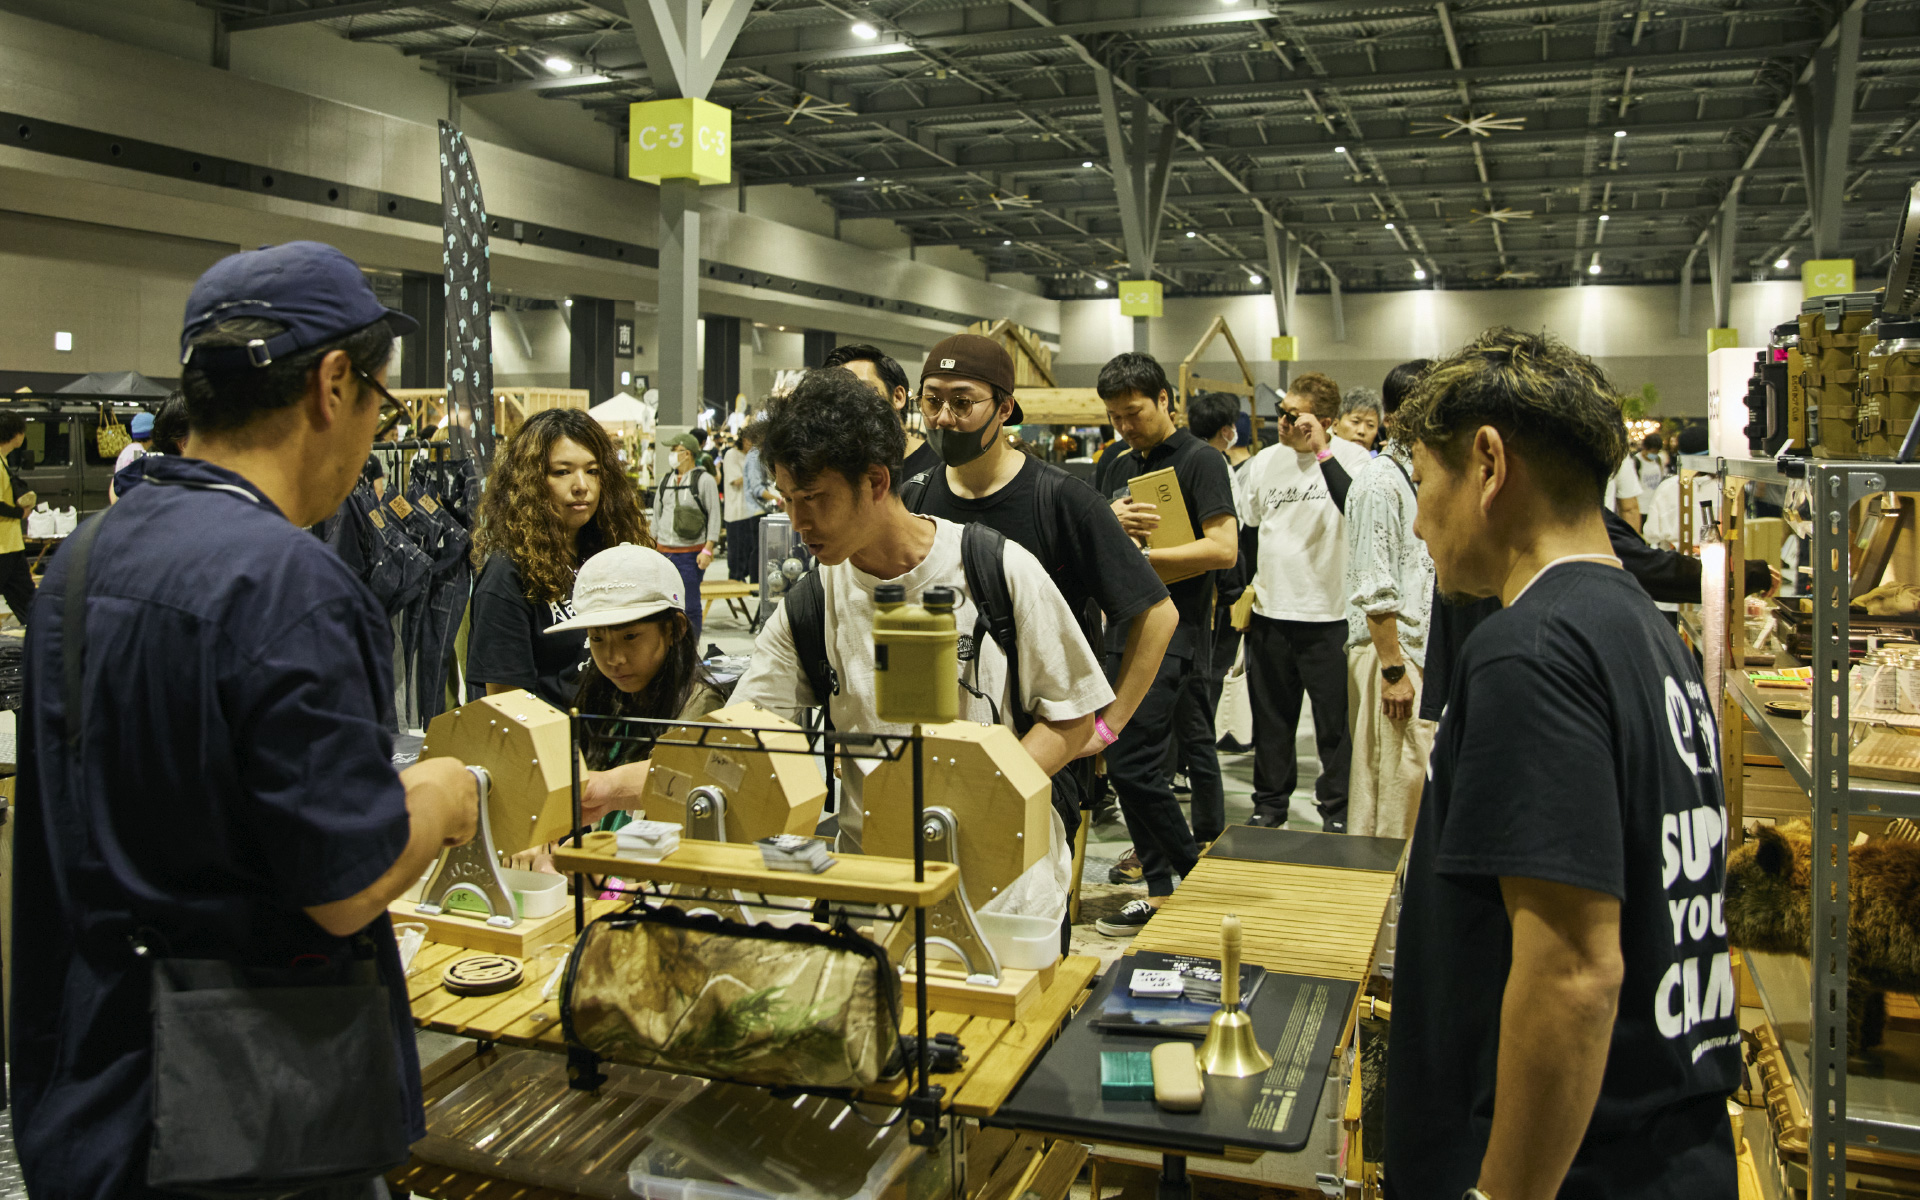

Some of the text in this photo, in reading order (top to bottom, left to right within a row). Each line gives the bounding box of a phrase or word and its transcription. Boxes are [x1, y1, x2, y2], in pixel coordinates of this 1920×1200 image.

[639, 123, 684, 151] C-3
[698, 126, 726, 156] C-3
[1814, 273, 1847, 288] C-2
[1124, 292, 1149, 304] C-2
[1662, 805, 1728, 889] SUP
